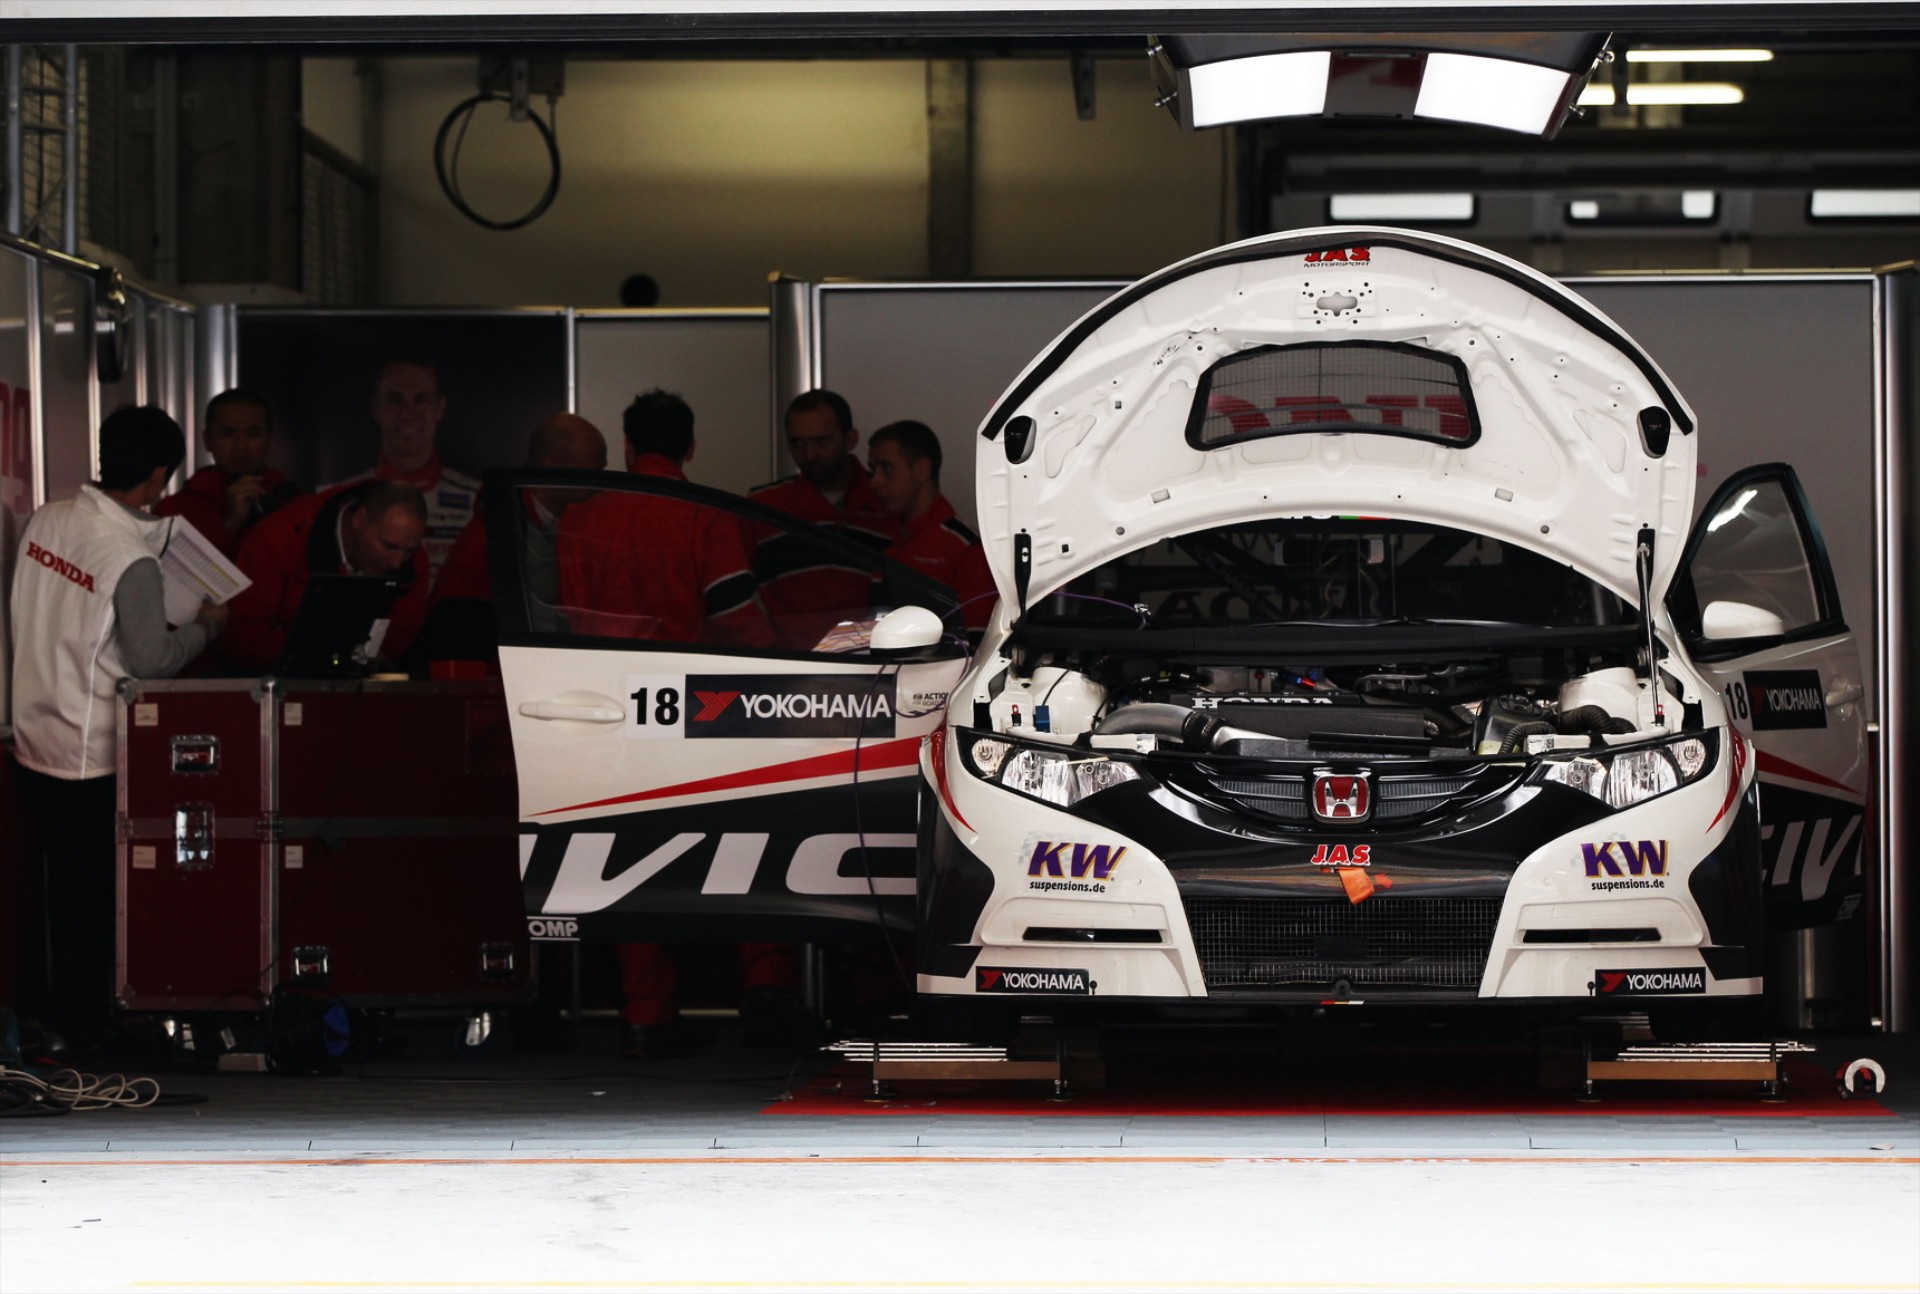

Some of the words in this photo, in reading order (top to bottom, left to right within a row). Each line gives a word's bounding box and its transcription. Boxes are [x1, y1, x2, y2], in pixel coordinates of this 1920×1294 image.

[26, 541, 95, 594] HONDA
[630, 687, 680, 725] 18
[740, 693, 892, 719] YOKOHAMA
[1725, 682, 1748, 720] 18
[1765, 688, 1822, 711] YOKOHAMA
[1027, 841, 1128, 880] KW
[1580, 840, 1668, 878] KW
[1029, 881, 1106, 893] suspensions.de
[1591, 879, 1665, 892] suspensions.de
[528, 919, 579, 937] OMP
[1002, 973, 1085, 990] YOKOHAMA
[1626, 973, 1703, 990] YOKOHAMA
